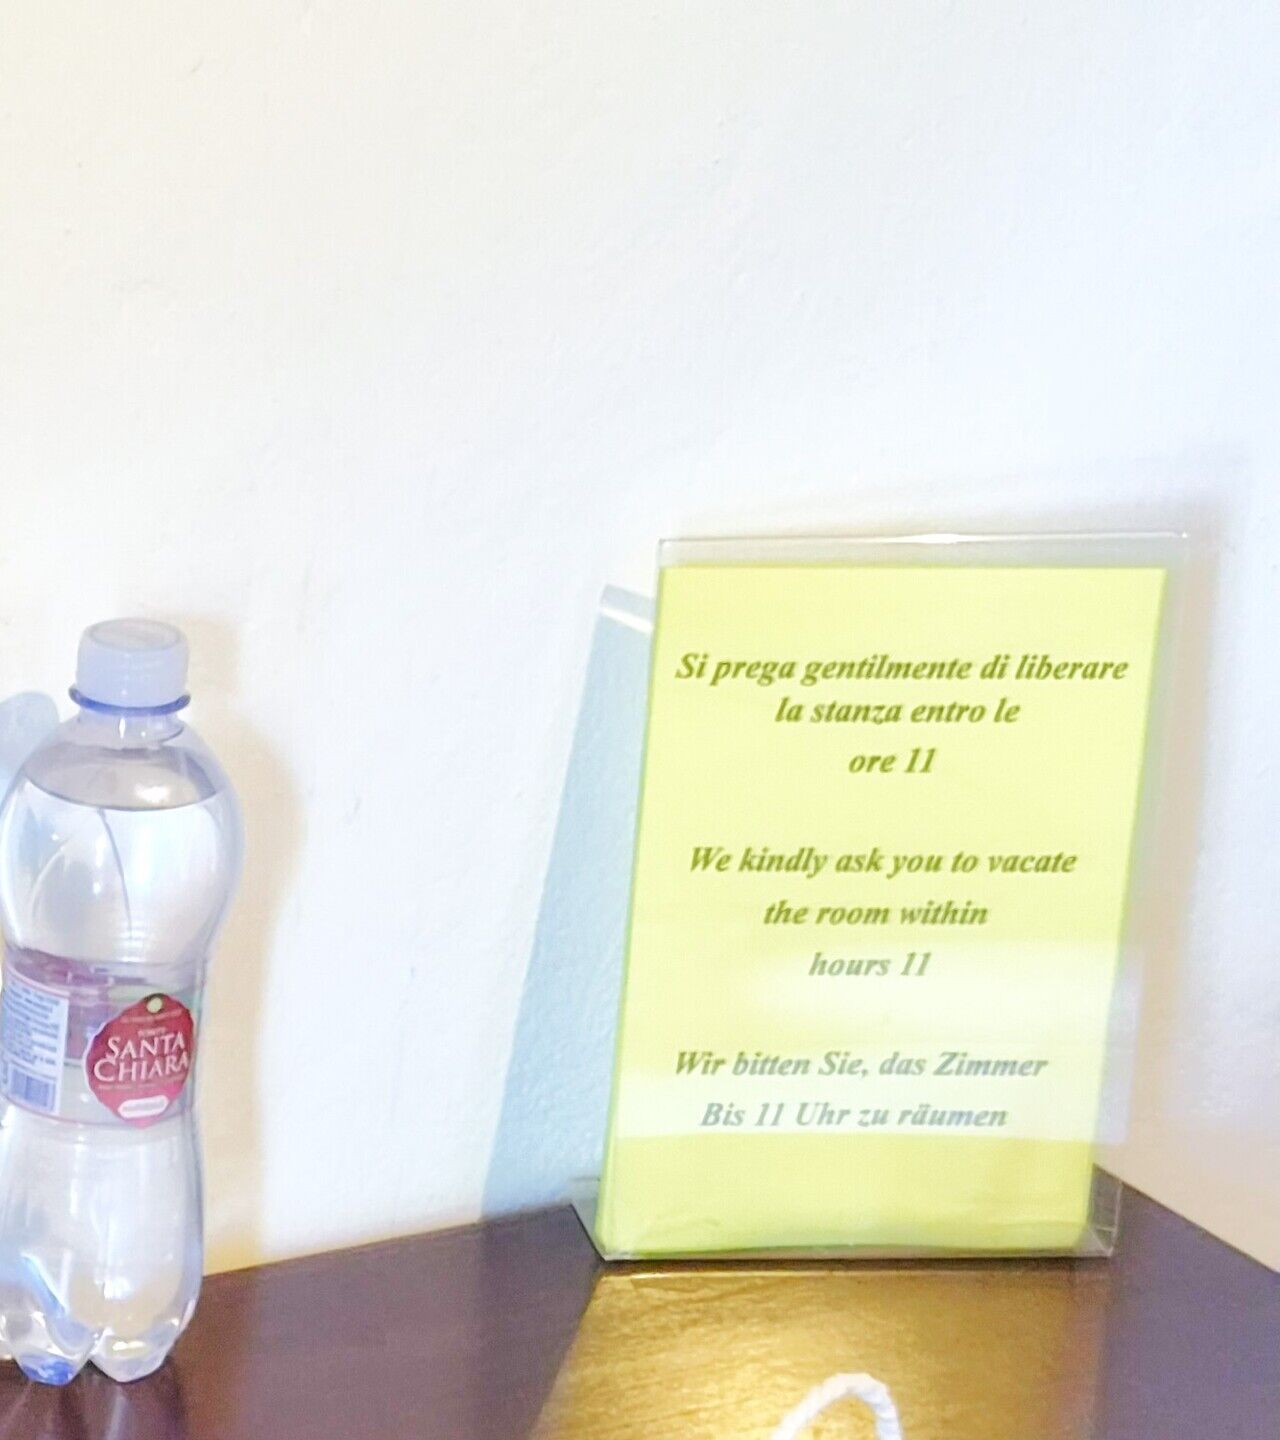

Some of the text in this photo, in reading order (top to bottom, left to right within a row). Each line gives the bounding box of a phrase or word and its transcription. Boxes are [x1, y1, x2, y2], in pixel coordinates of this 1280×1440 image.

[674, 653, 1129, 687] Si prega gentilmente di liberare
[774, 696, 1021, 725] la stanza entro le
[848, 747, 937, 774] ore 11
[690, 846, 1078, 880] We kindly ask you to vacate
[763, 899, 988, 926] the room within
[808, 951, 932, 977] hours 11
[107, 1031, 186, 1059] SANTA
[93, 1051, 189, 1082] CHIARA
[675, 1050, 1050, 1078] Wir bitten Sie, das Zimmer
[699, 1100, 1010, 1128] Bis 11 Uhr zu räumen
